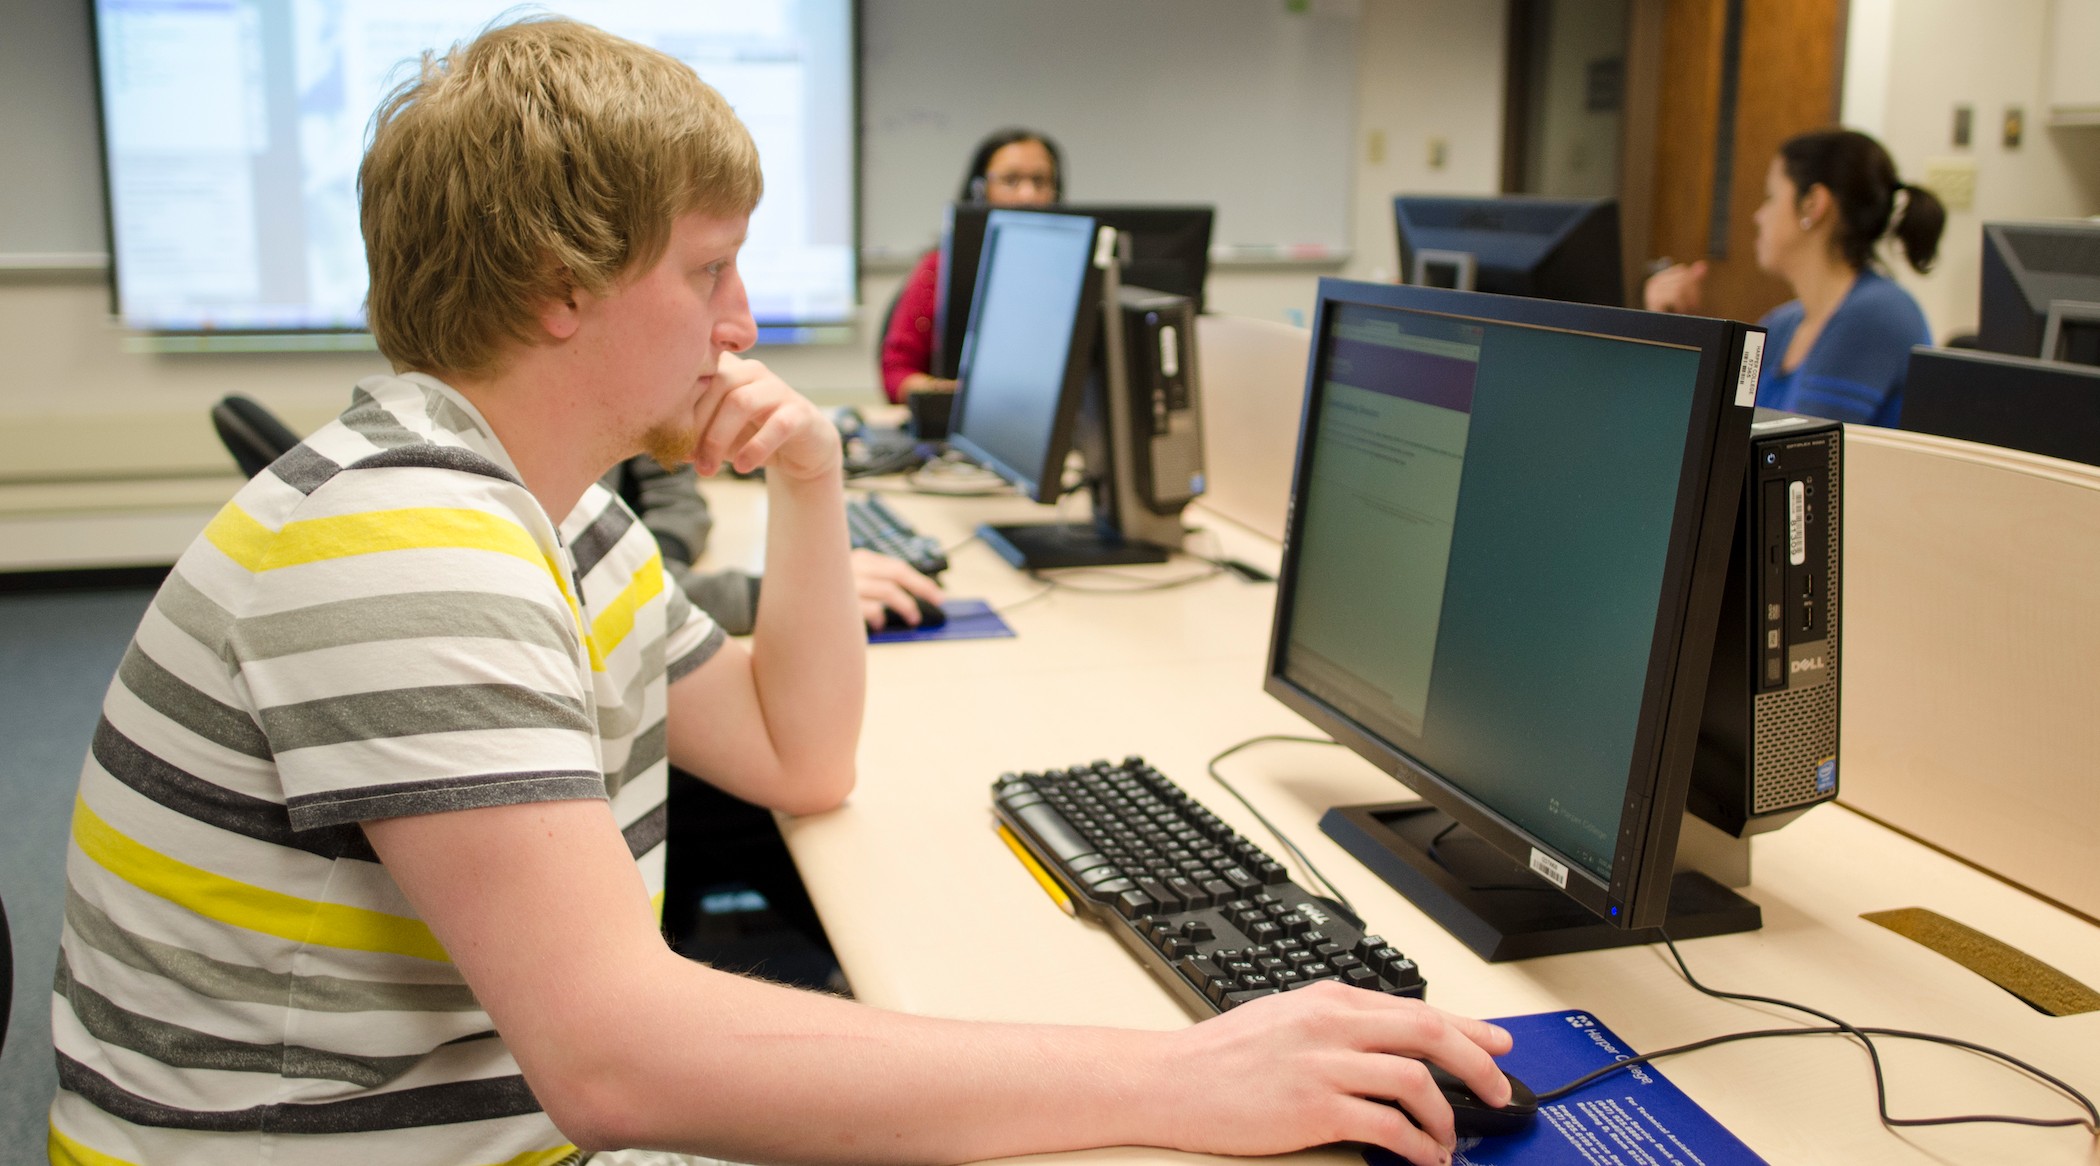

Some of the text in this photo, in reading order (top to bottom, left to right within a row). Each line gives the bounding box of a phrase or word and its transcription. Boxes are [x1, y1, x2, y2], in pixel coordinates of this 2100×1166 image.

[1749, 345, 1761, 395] HARPER COLLEGE
[1791, 656, 1825, 673] DELL
[1297, 903, 1330, 925] DELL
[1584, 1028, 1654, 1085] Harper Cllege
[1546, 1105, 1566, 1121] (847)
[1590, 1146, 1600, 1154] or
[1557, 1104, 1587, 1132] Employee
[1586, 1131, 1611, 1155] Service
[1576, 1102, 1603, 1126] Building
[1609, 1132, 1629, 1150] Room
[1595, 1100, 1615, 1115] (847)
[1606, 1098, 1632, 1121] Student
[1630, 1120, 1657, 1143] Service
[1655, 1143, 1674, 1159] Desk
[1624, 1096, 1638, 1106] For
[1637, 1106, 1671, 1135] Technical
